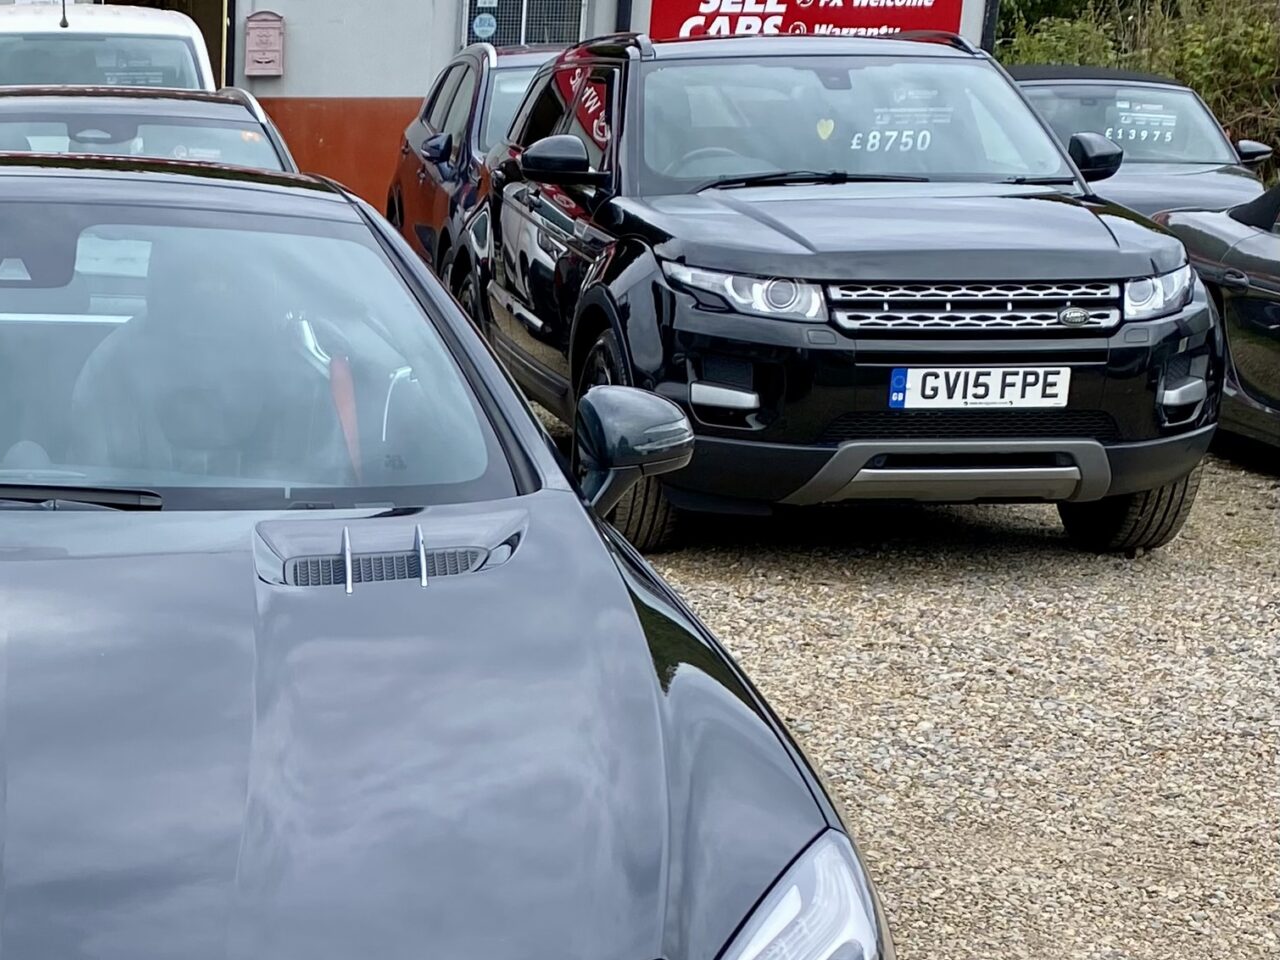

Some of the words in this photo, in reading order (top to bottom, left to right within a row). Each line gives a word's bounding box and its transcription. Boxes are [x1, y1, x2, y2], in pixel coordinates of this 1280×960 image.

[679, 15, 783, 37] CARS
[850, 130, 931, 152] £8750
[1105, 127, 1172, 142] £13975
[920, 371, 991, 400] GV15
[999, 370, 1061, 399] FPE
